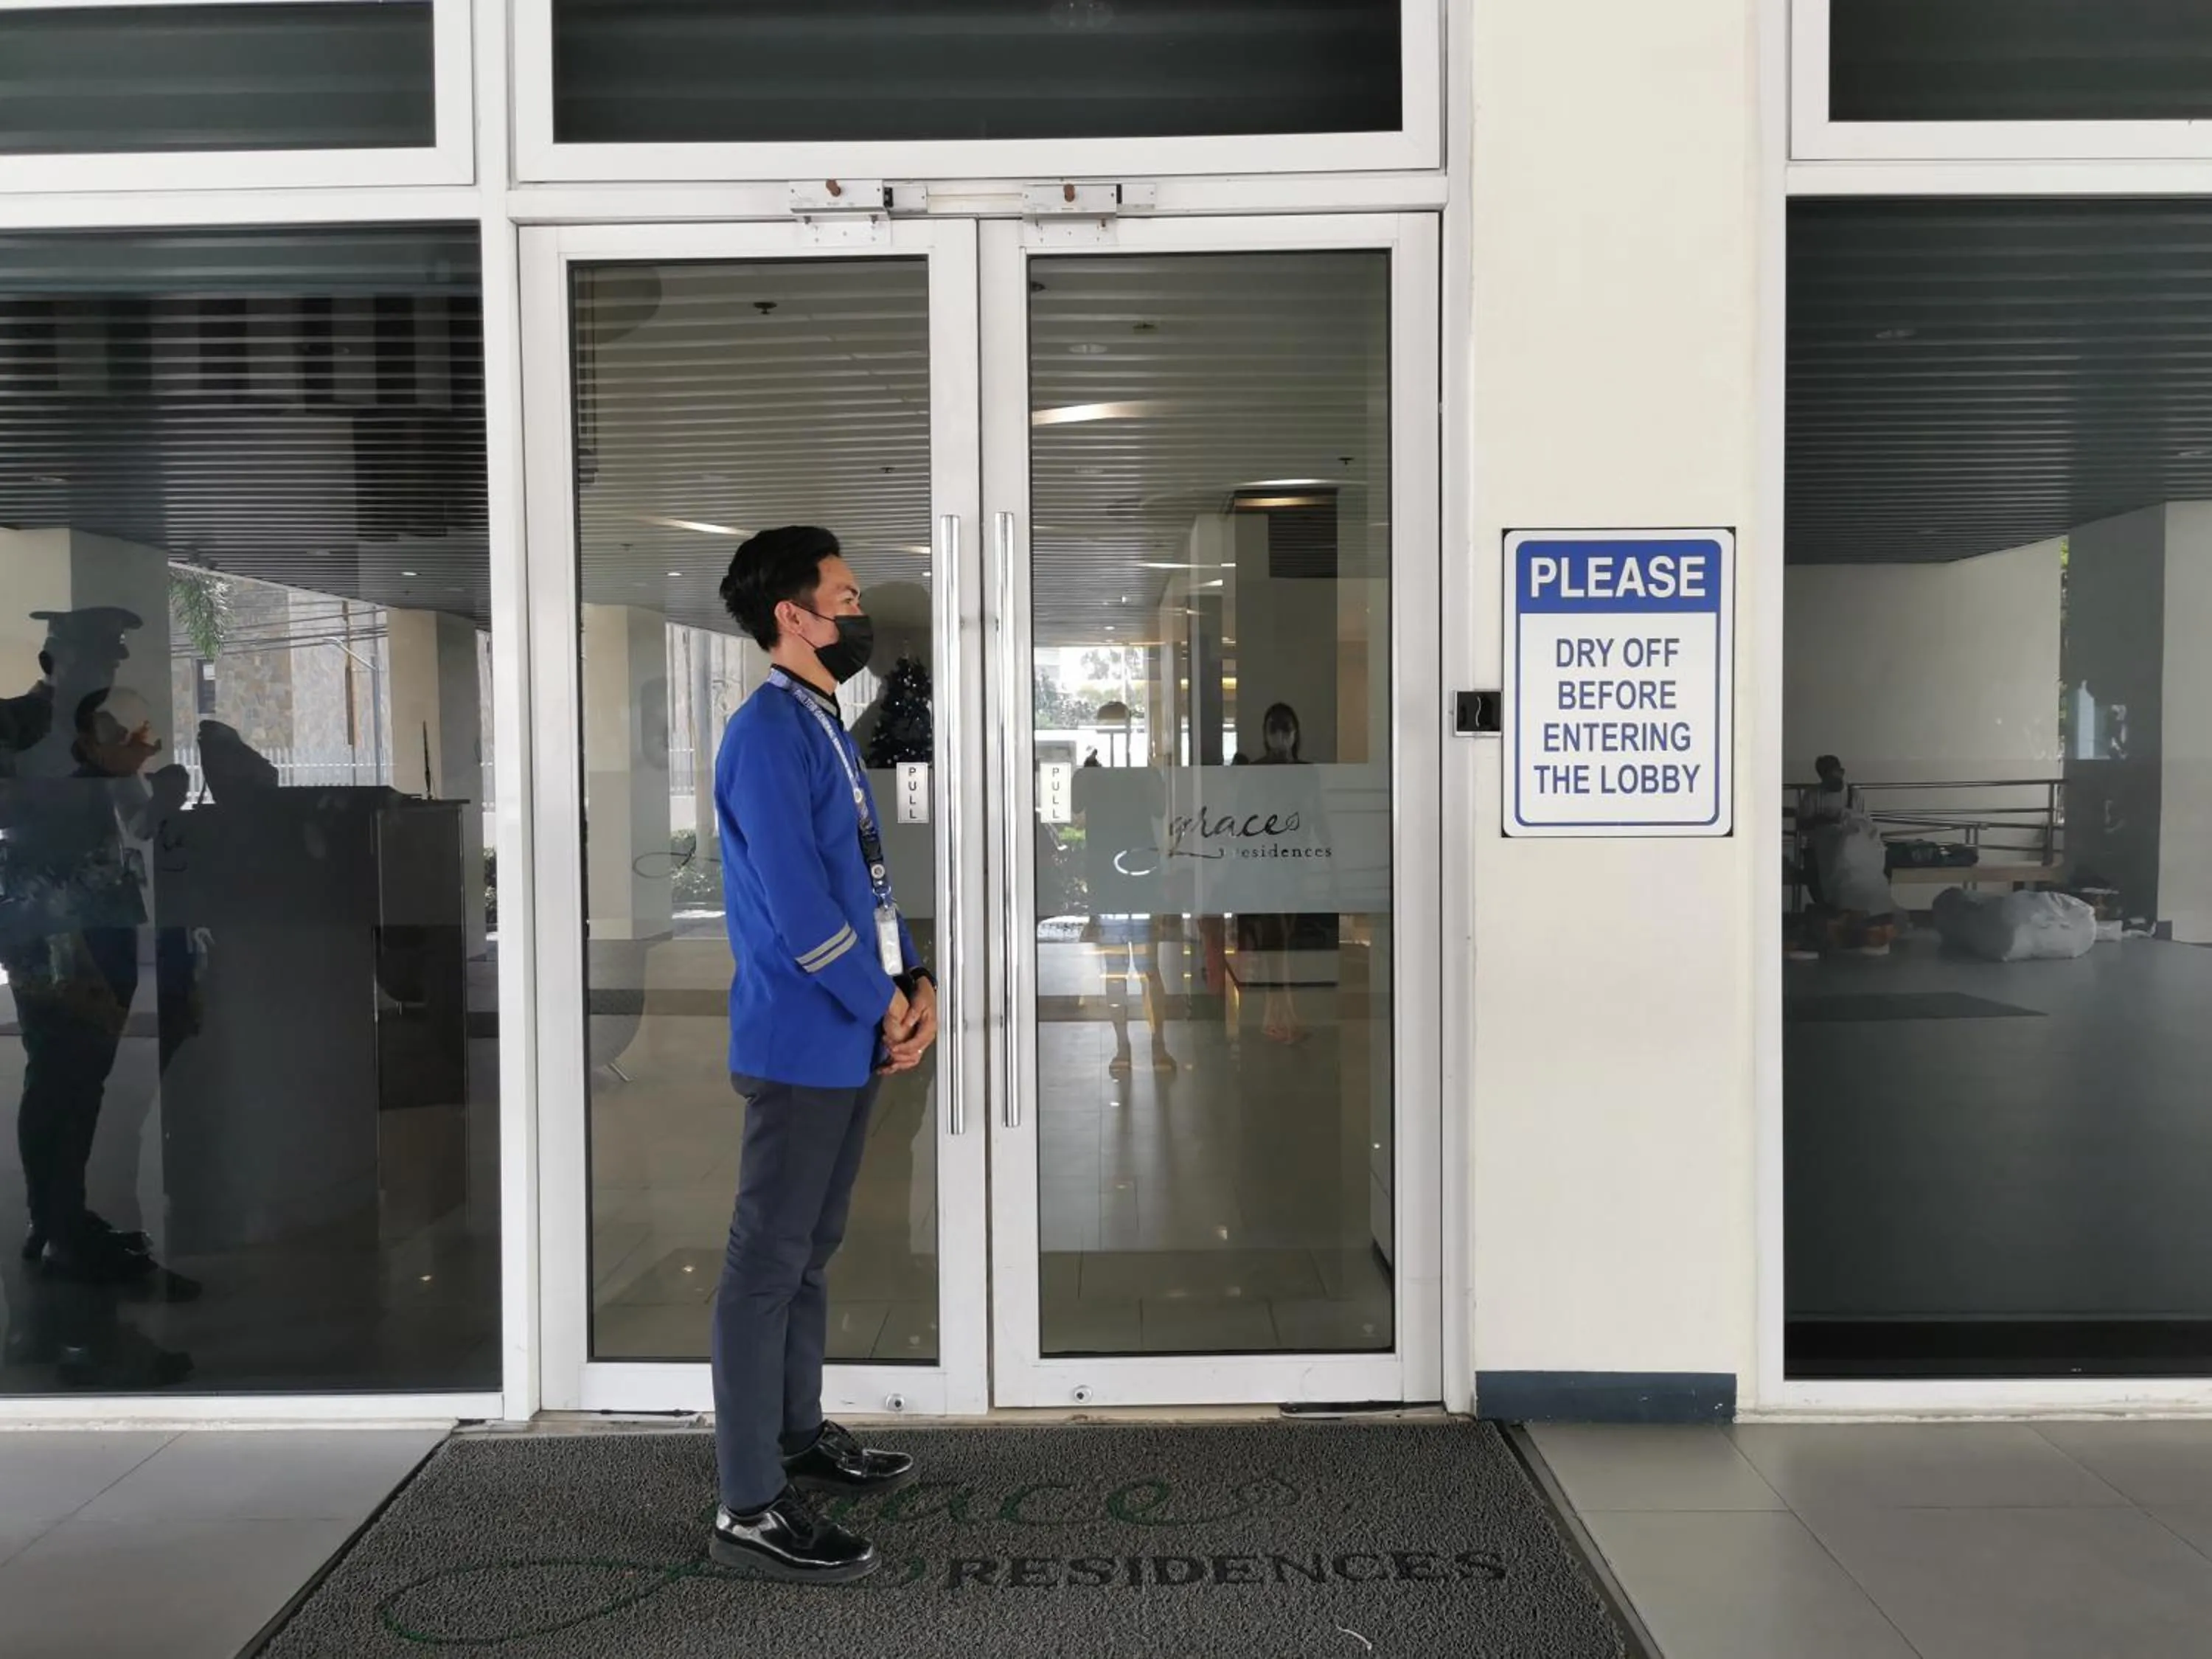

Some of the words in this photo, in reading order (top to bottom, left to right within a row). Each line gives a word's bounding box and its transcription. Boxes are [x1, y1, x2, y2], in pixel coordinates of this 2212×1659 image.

[1530, 555, 1706, 599] PLEASE
[1556, 638, 1615, 667] DRY
[1623, 637, 1680, 667] OFF
[1557, 680, 1677, 710] BEFORE
[1543, 722, 1691, 752] ENTERING
[908, 766, 917, 819] PULL
[1051, 767, 1060, 819] PULL
[1534, 765, 1590, 794] THE
[1600, 764, 1701, 794] LOBBY
[1233, 843, 1332, 858] esidences
[947, 1550, 1509, 1587] RESIDENCES
